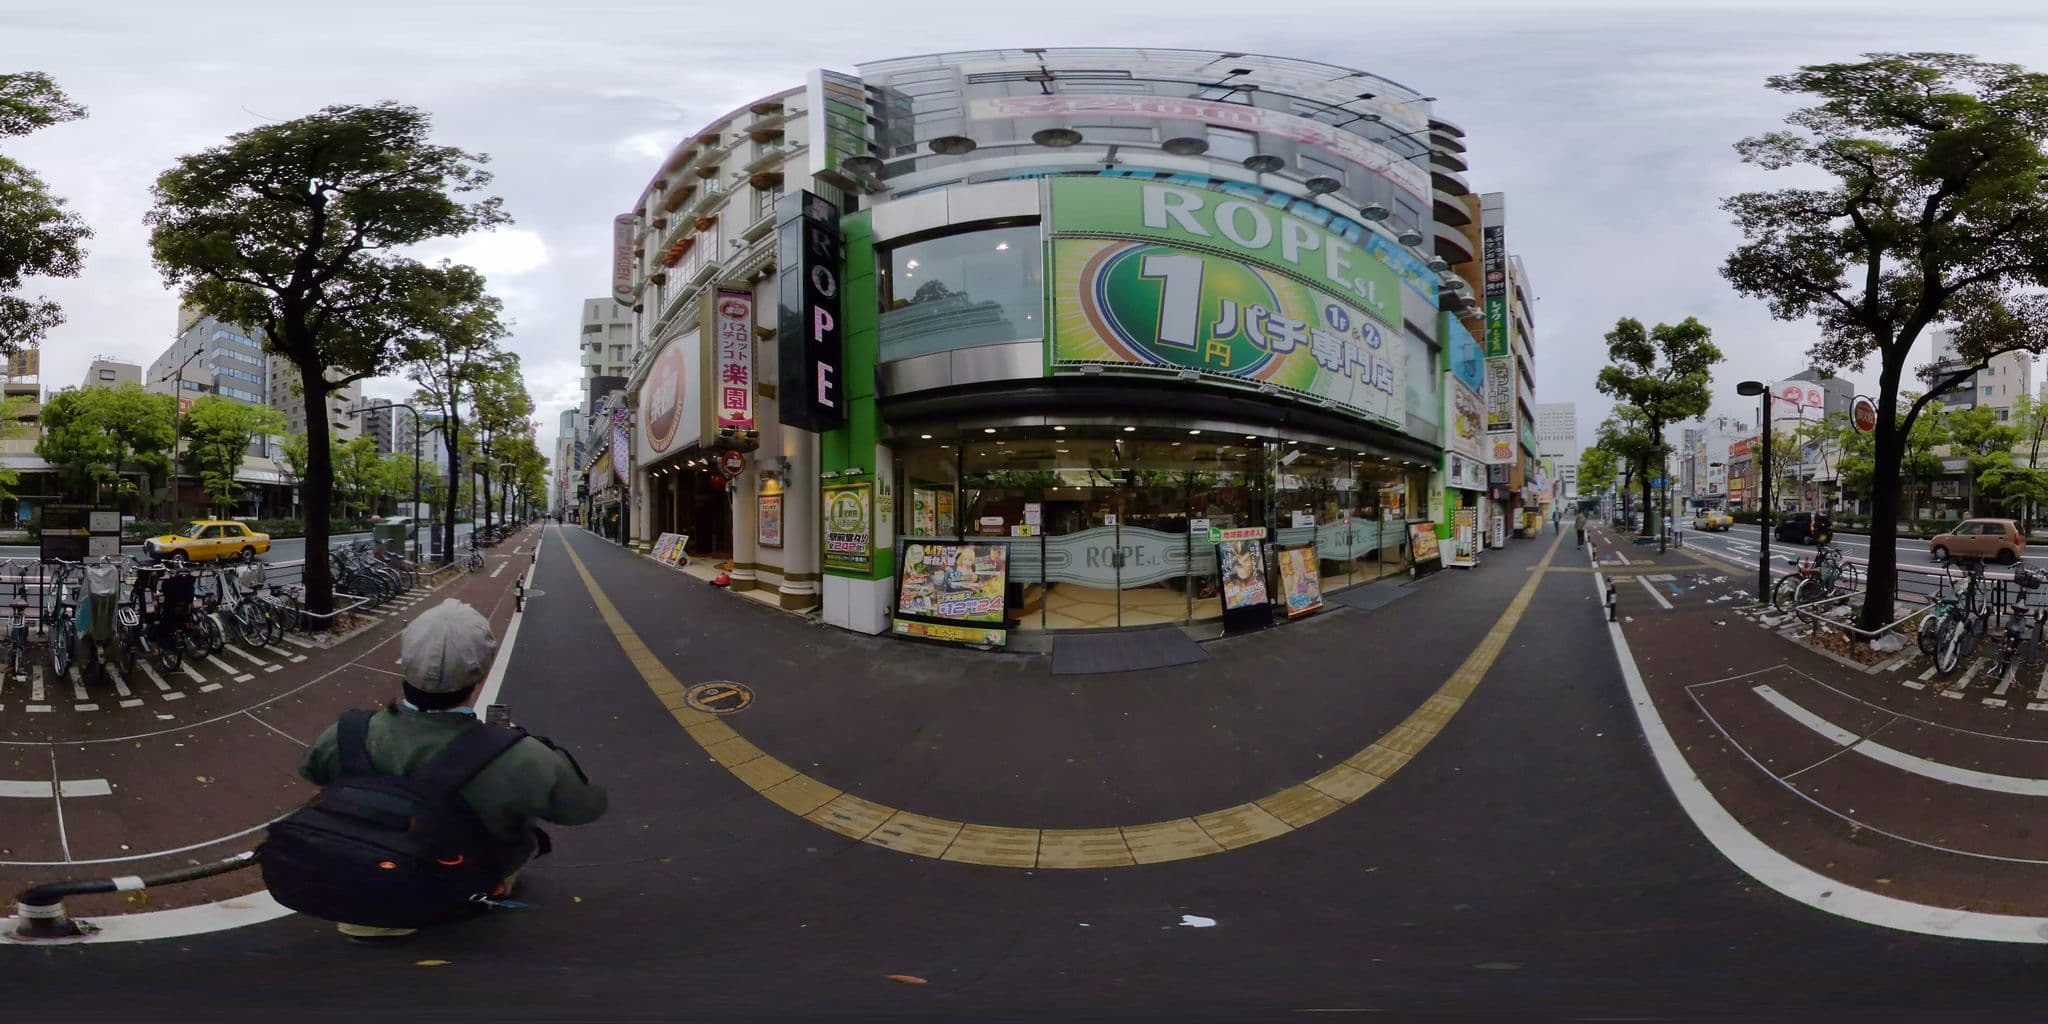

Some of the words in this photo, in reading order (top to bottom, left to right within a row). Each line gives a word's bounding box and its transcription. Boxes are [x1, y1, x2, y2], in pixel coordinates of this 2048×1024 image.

[1142, 184, 1353, 289] ROPE
[811, 227, 836, 408] ROPE
[723, 321, 735, 359] パチンコ
[737, 323, 748, 360] スロット
[723, 363, 748, 410] 楽園
[1086, 545, 1145, 568] ROPE
